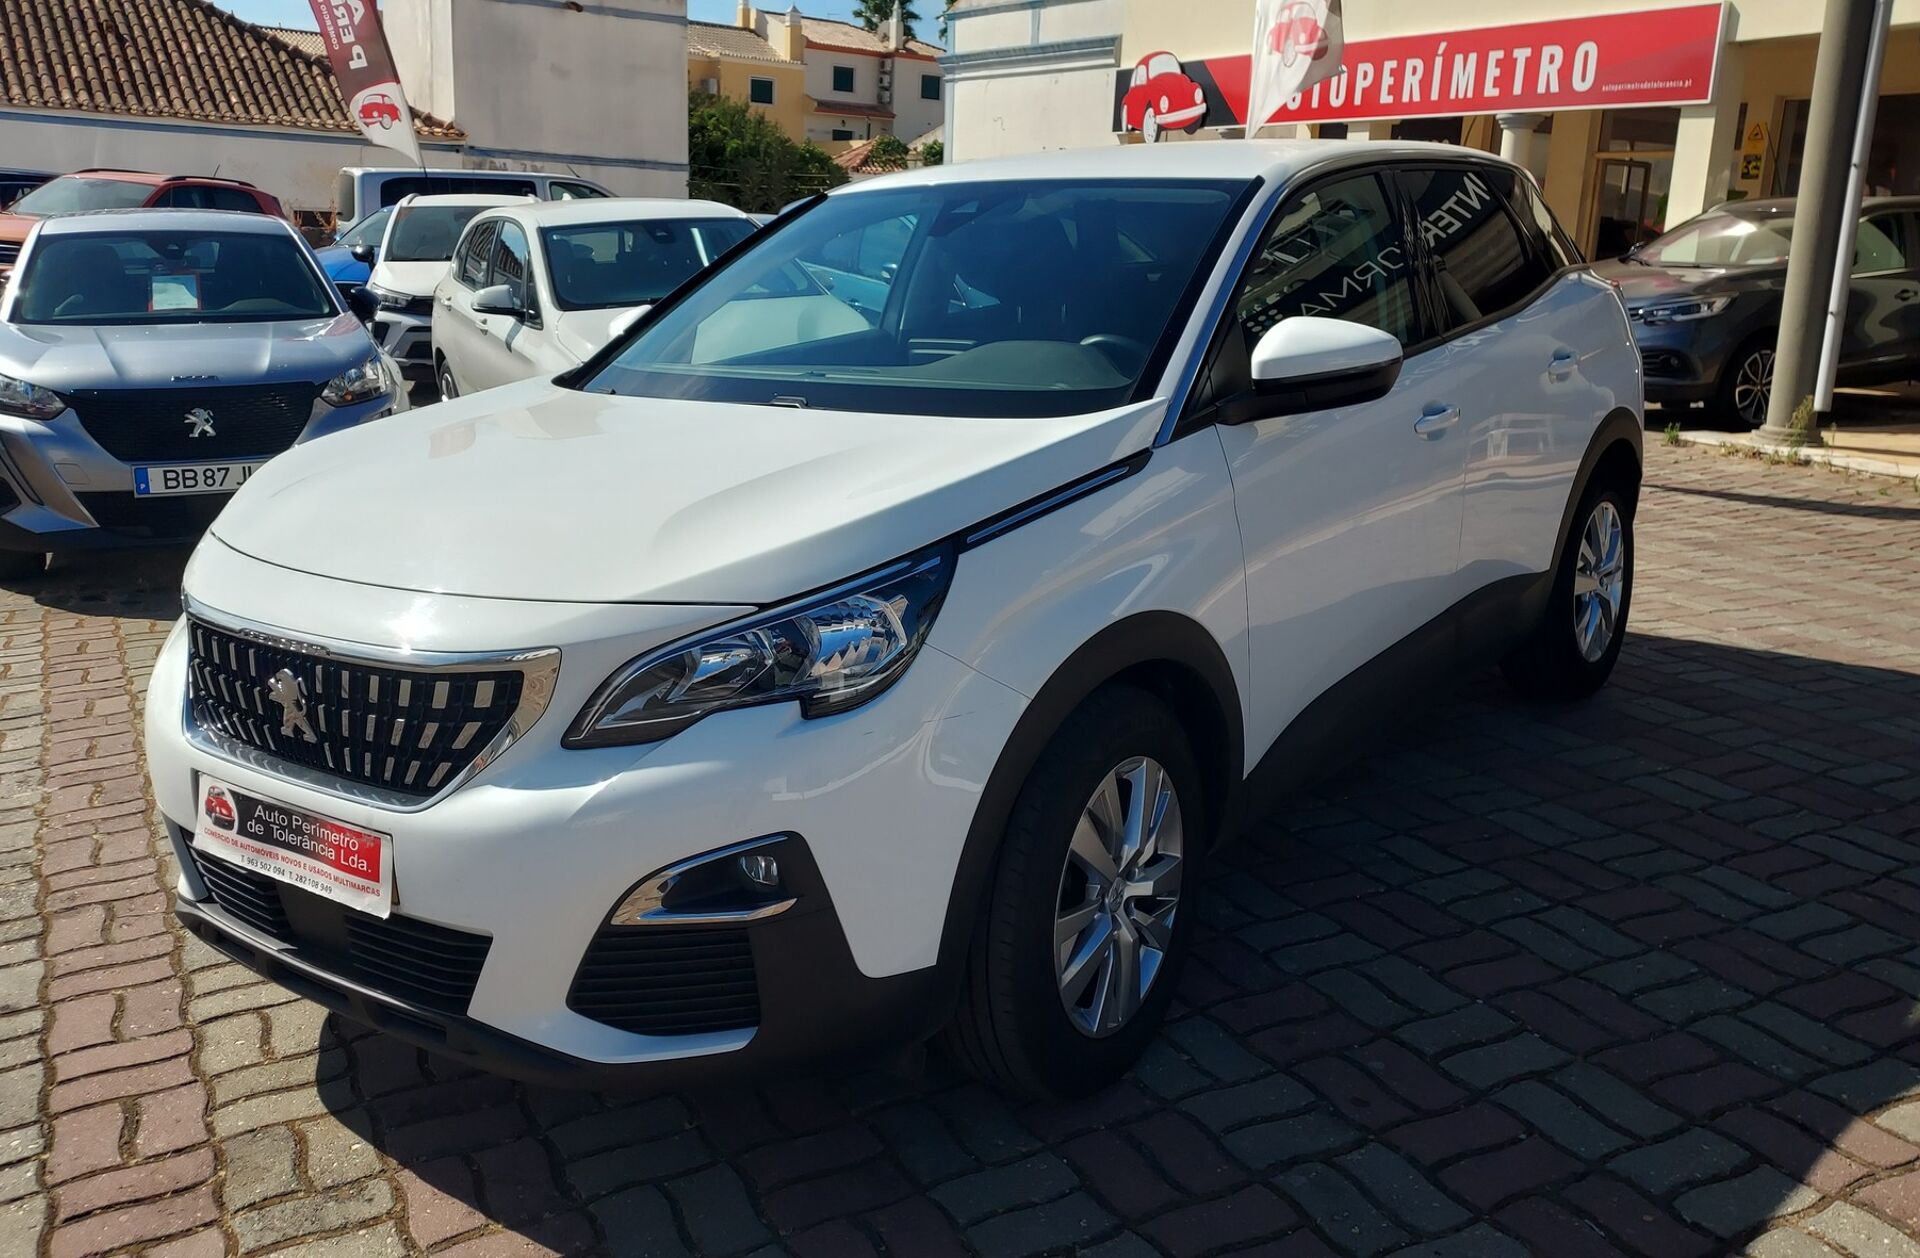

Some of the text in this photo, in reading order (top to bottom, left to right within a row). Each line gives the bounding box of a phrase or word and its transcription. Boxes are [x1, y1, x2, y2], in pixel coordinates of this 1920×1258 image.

[1286, 41, 1598, 111] TOPERÍMETRO
[163, 469, 199, 489] BB
[202, 467, 230, 487] 87
[254, 805, 288, 826] Auto
[247, 819, 372, 873] de Tolerância Lda.
[247, 857, 259, 868] 963
[260, 862, 272, 872] 502
[281, 855, 302, 869] NOVOS
[308, 863, 333, 881] USADOS
[333, 875, 381, 897] MULTIMARCAS
